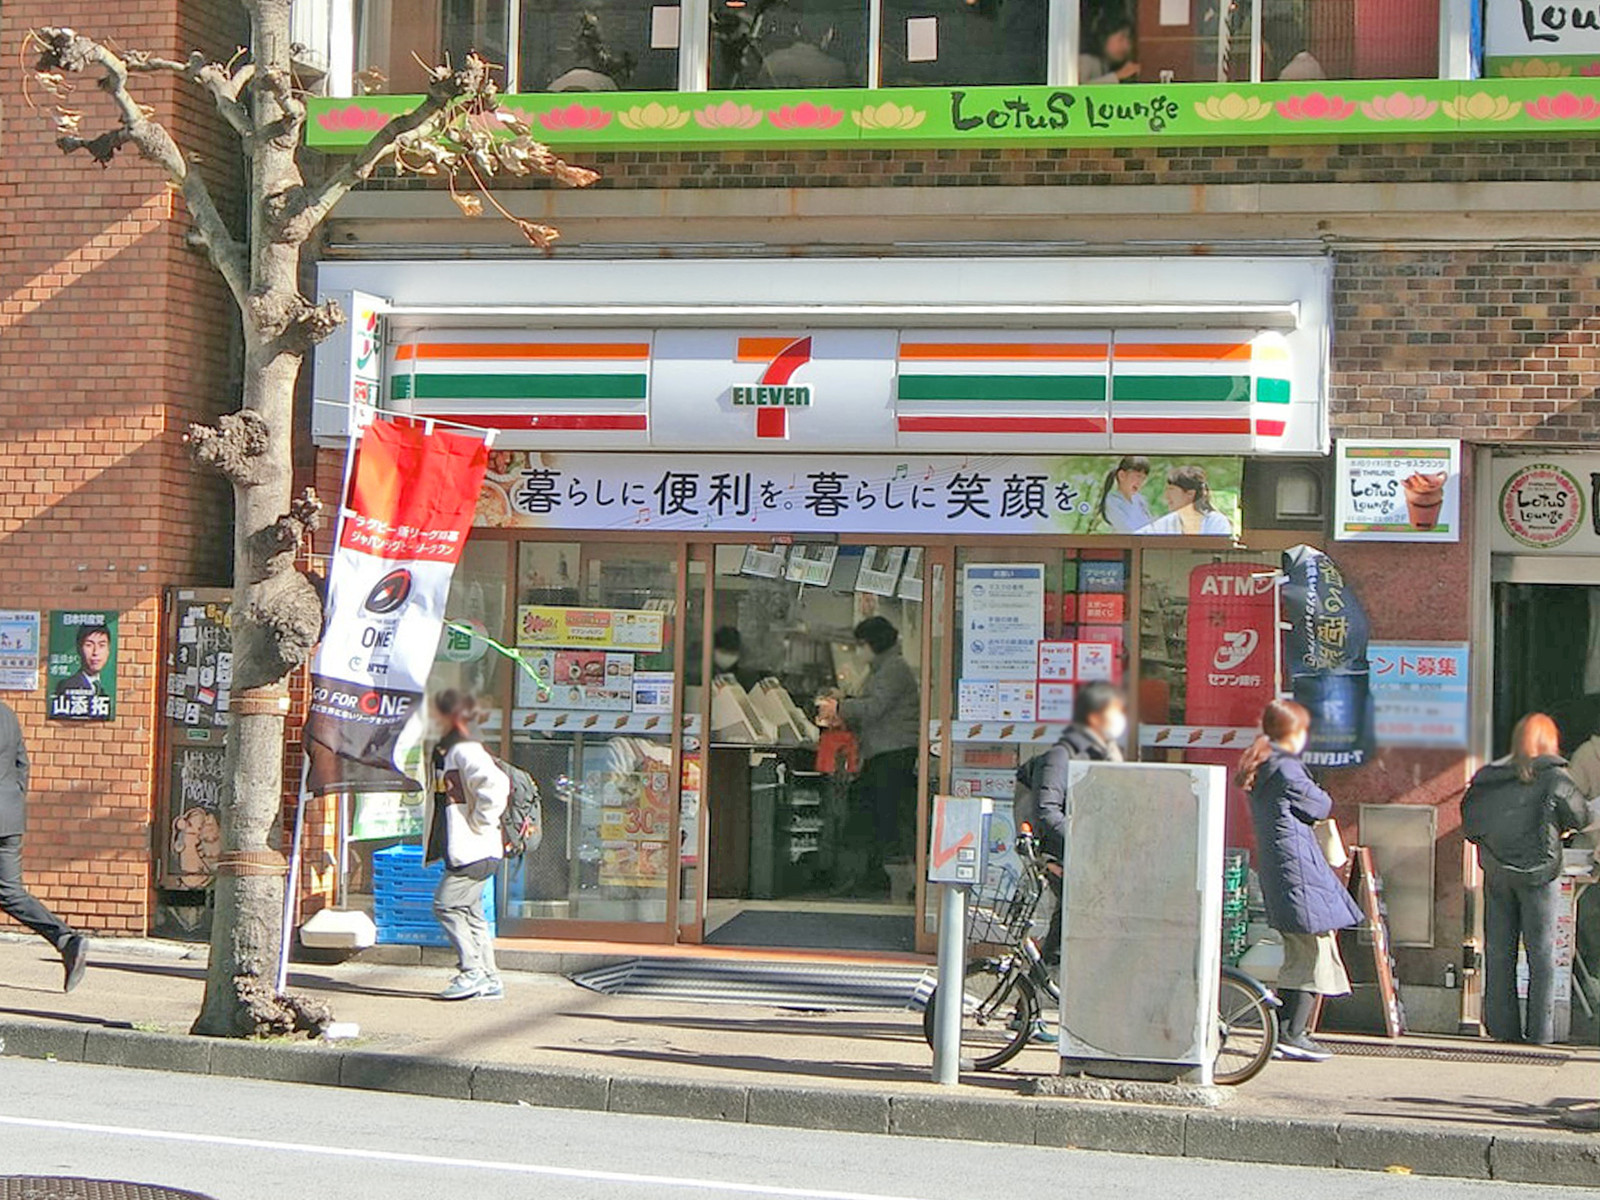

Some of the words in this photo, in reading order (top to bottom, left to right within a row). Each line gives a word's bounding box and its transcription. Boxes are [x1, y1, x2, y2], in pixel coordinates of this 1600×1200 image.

[1520, 0, 1600, 42] Lou
[1086, 95, 1179, 131] Lounge
[1353, 499, 1394, 514] Lounge
[1520, 509, 1563, 524] Lounge
[1201, 575, 1254, 596] ATM
[362, 627, 392, 648] ONE
[1368, 656, 1457, 677] ント募集
[1208, 674, 1261, 687] セブン銀行
[330, 692, 358, 708] FOR
